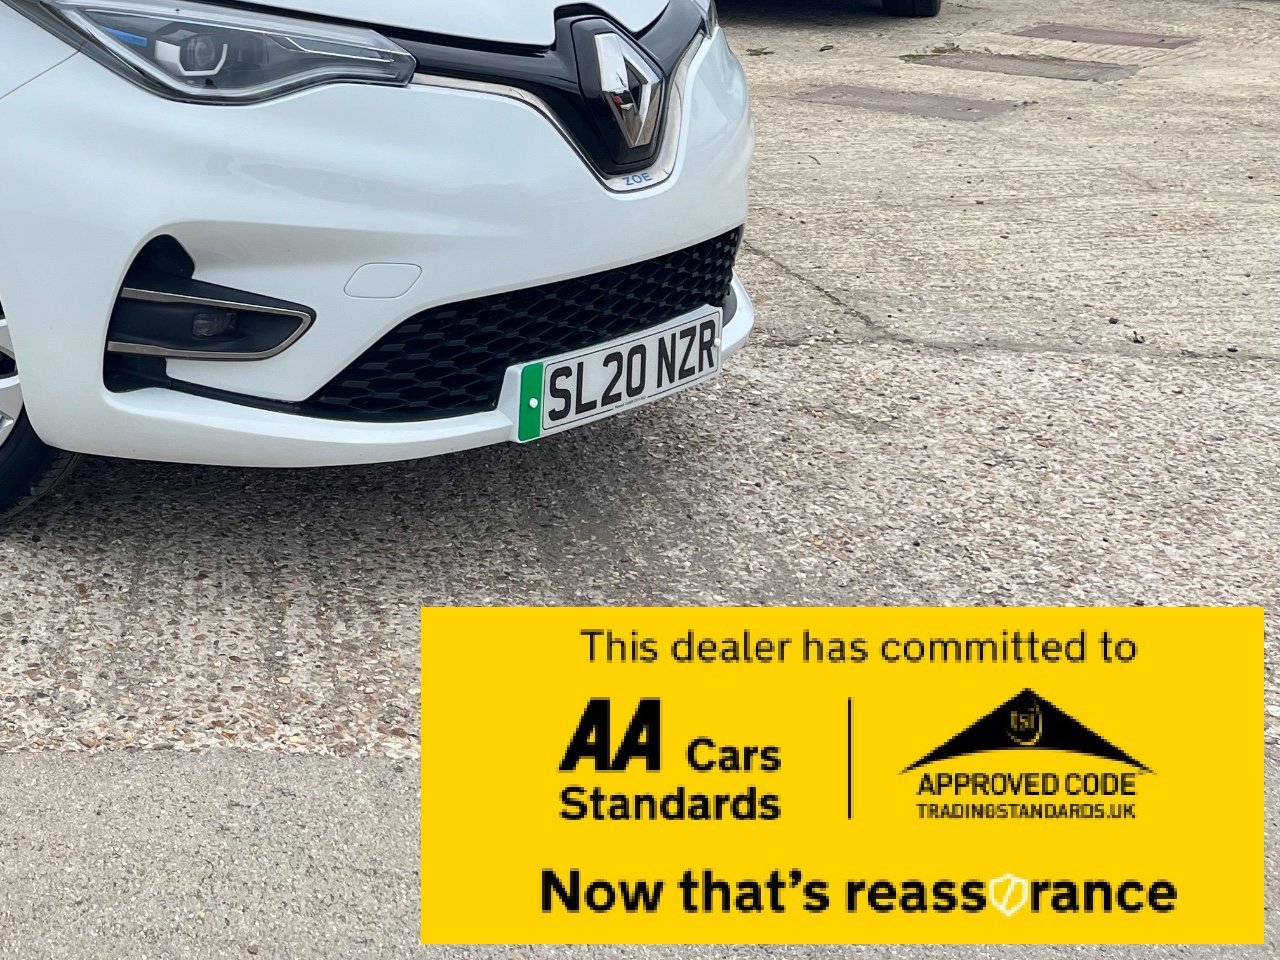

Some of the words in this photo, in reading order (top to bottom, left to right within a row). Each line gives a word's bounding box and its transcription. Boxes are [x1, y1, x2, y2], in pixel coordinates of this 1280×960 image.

[622, 172, 653, 186] ZOE
[548, 343, 647, 421] SL20
[656, 319, 716, 389] NZR
